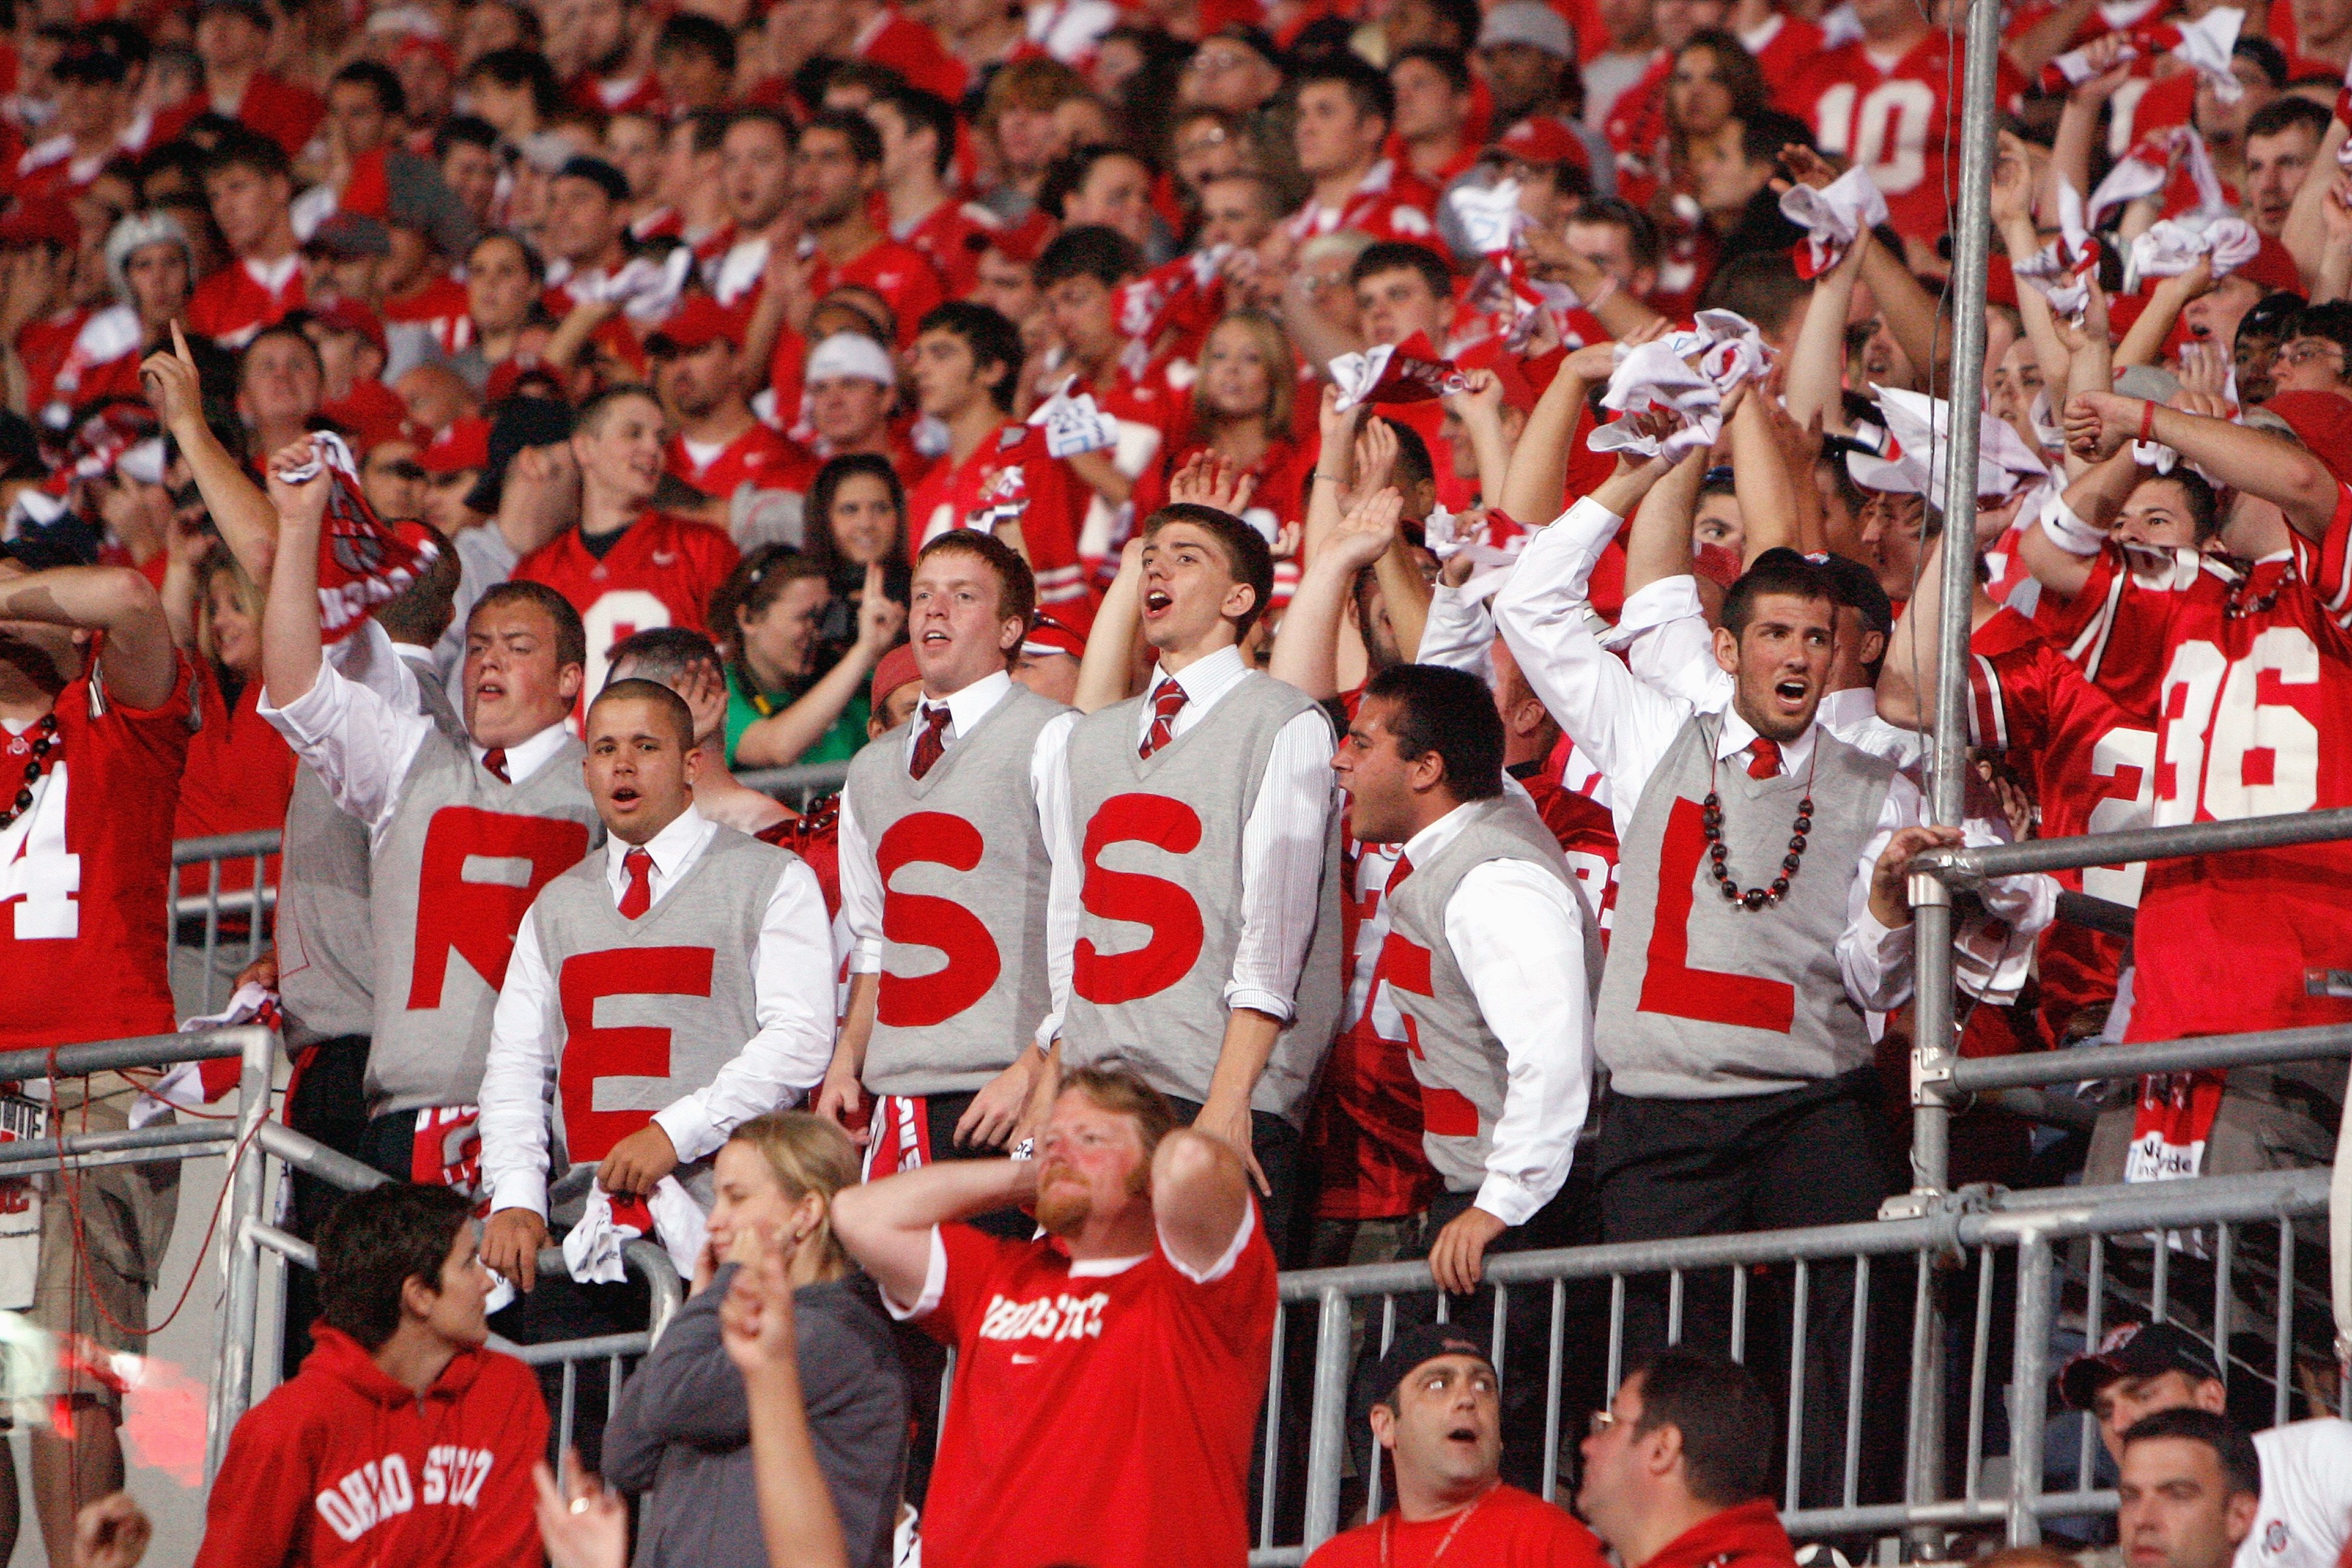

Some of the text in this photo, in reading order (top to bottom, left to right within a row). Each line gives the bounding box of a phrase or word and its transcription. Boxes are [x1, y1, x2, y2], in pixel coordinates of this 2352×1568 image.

[1814, 78, 1935, 195] 10
[2152, 626, 2320, 829] 36
[406, 806, 589, 1011] R
[875, 811, 1001, 1027] S
[1073, 792, 1204, 1005] S
[1636, 796, 1795, 1034] L
[558, 946, 716, 1163] E
[315, 1453, 415, 1543] OHIO
